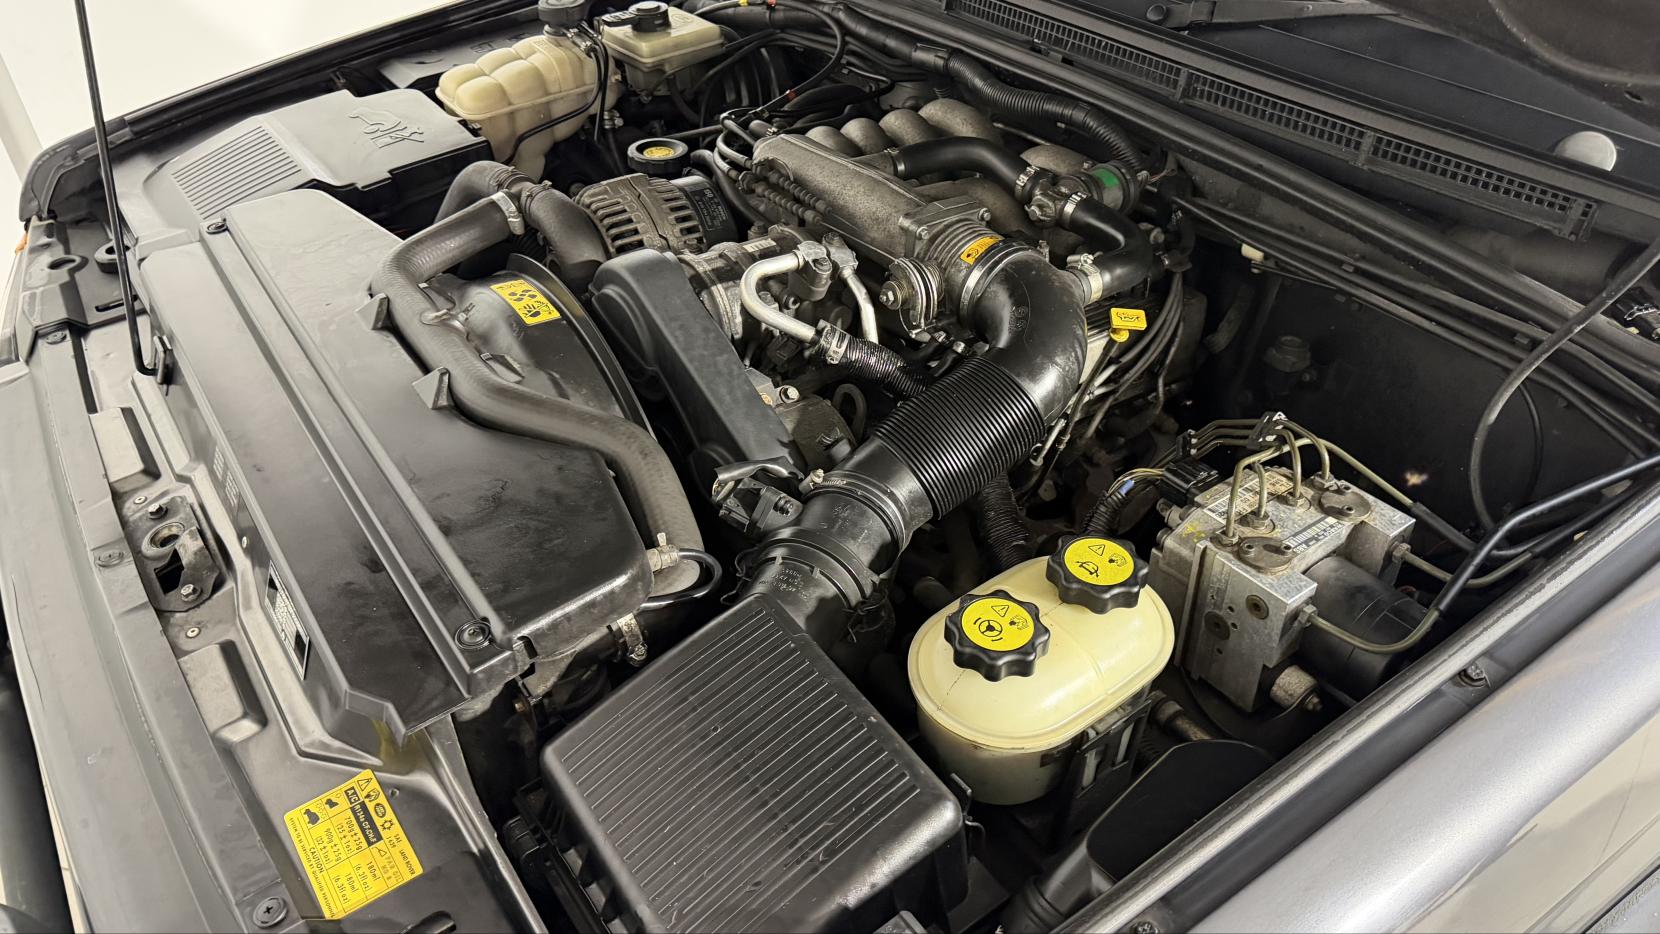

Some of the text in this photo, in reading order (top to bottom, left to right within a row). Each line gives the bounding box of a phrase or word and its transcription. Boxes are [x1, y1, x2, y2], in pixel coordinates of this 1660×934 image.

[346, 789, 359, 803] A/C
[354, 804, 367, 824] R134a
[343, 816, 357, 833] 700g
[353, 837, 365, 851] 25g
[309, 847, 325, 874] CAUTION
[332, 848, 344, 862] 25g
[366, 862, 380, 882] 180ml
[345, 873, 358, 893] 180ml
